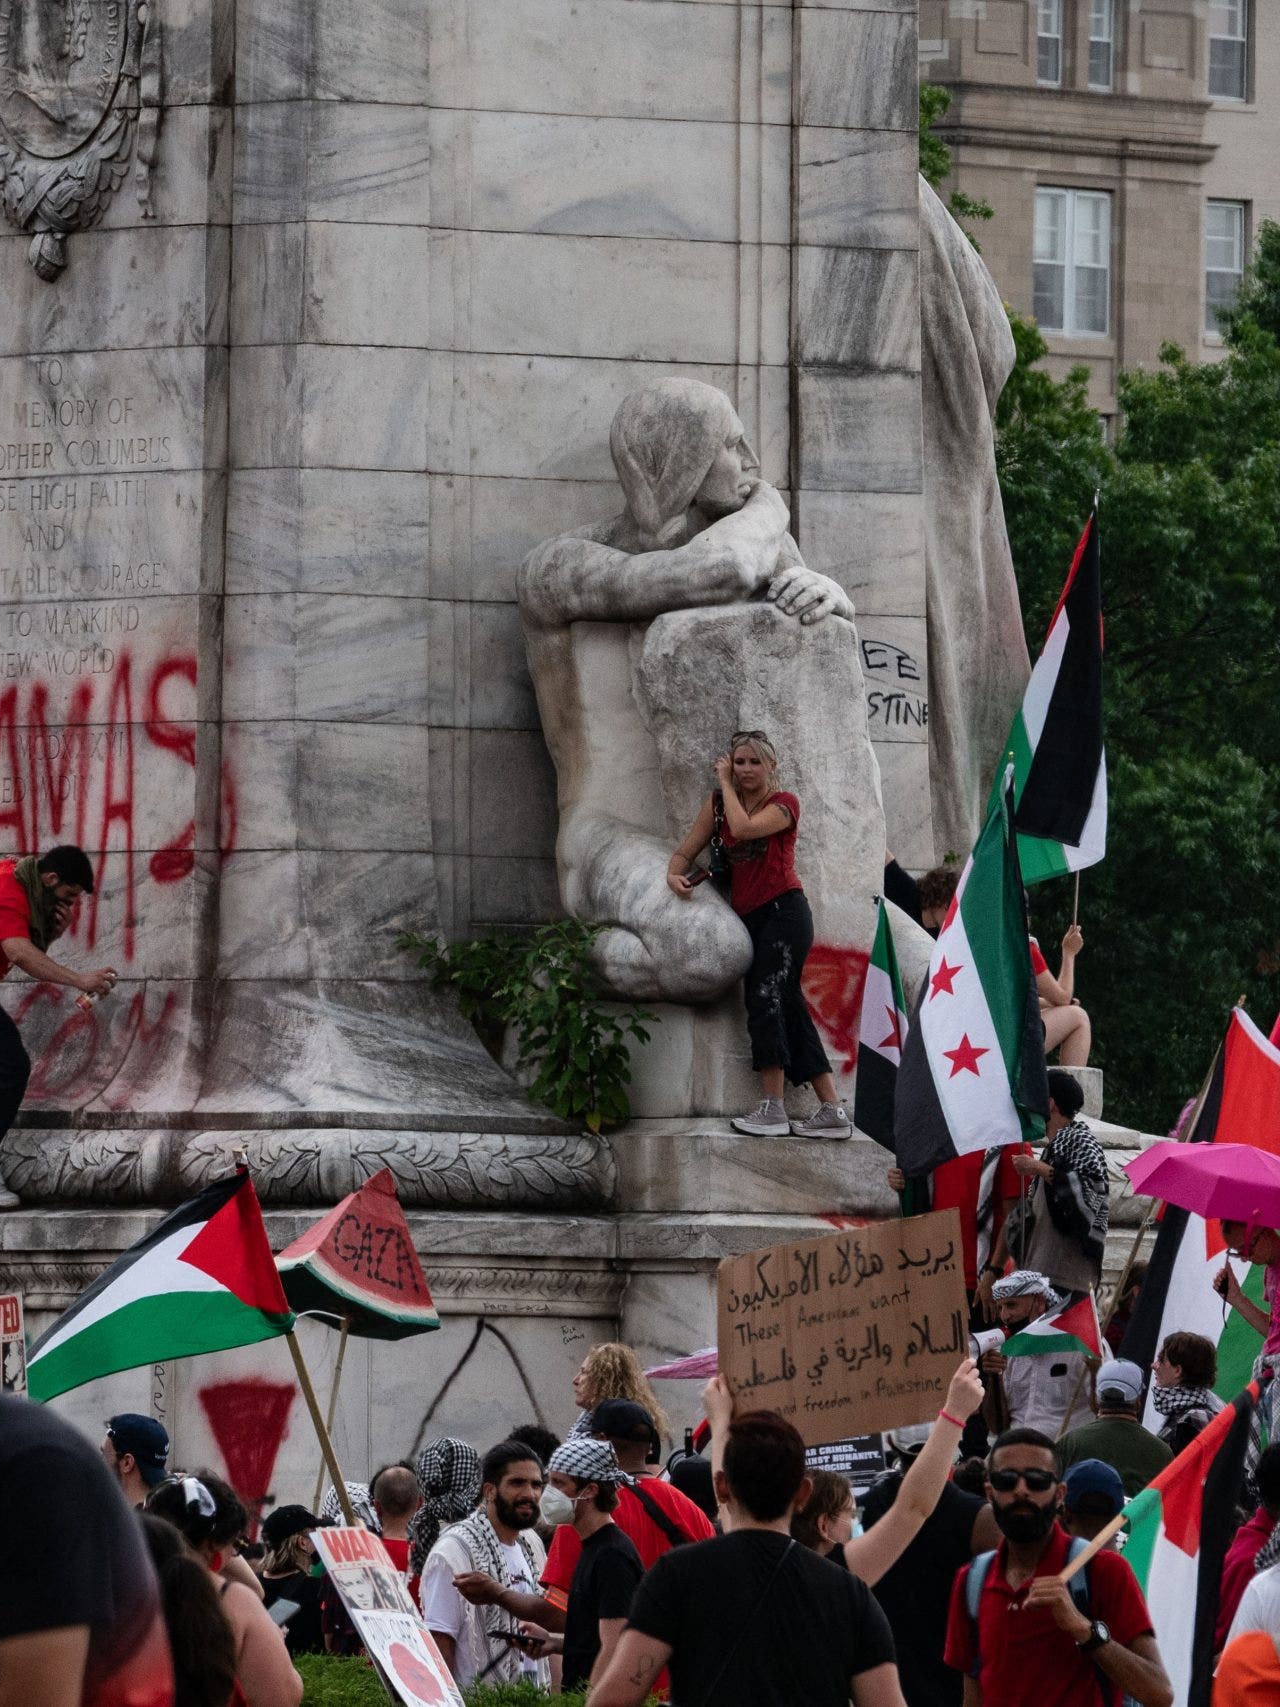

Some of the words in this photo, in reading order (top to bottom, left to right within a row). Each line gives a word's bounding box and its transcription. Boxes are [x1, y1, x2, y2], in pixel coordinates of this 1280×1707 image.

[38, 359, 63, 386] TO
[14, 399, 99, 430] MEMORY
[107, 397, 134, 424] OF
[66, 436, 172, 467] COLUMBUS
[30, 482, 78, 512] HIGH
[89, 479, 148, 509] FAITH
[22, 524, 65, 552] AND
[68, 562, 162, 596] COURAGE
[6, 611, 33, 638] TO
[44, 605, 141, 635] MANKIND
[45, 647, 116, 676] WORLD
[867, 691, 928, 727] STINE
[334, 1214, 420, 1294] GAZA
[898, 1241, 955, 1277] يريد
[734, 1322, 782, 1346] These
[870, 1283, 912, 1309] want
[806, 1347, 830, 1387] في
[805, 1448, 817, 1457] AR
[808, 1462, 853, 1472] NOCIDE
